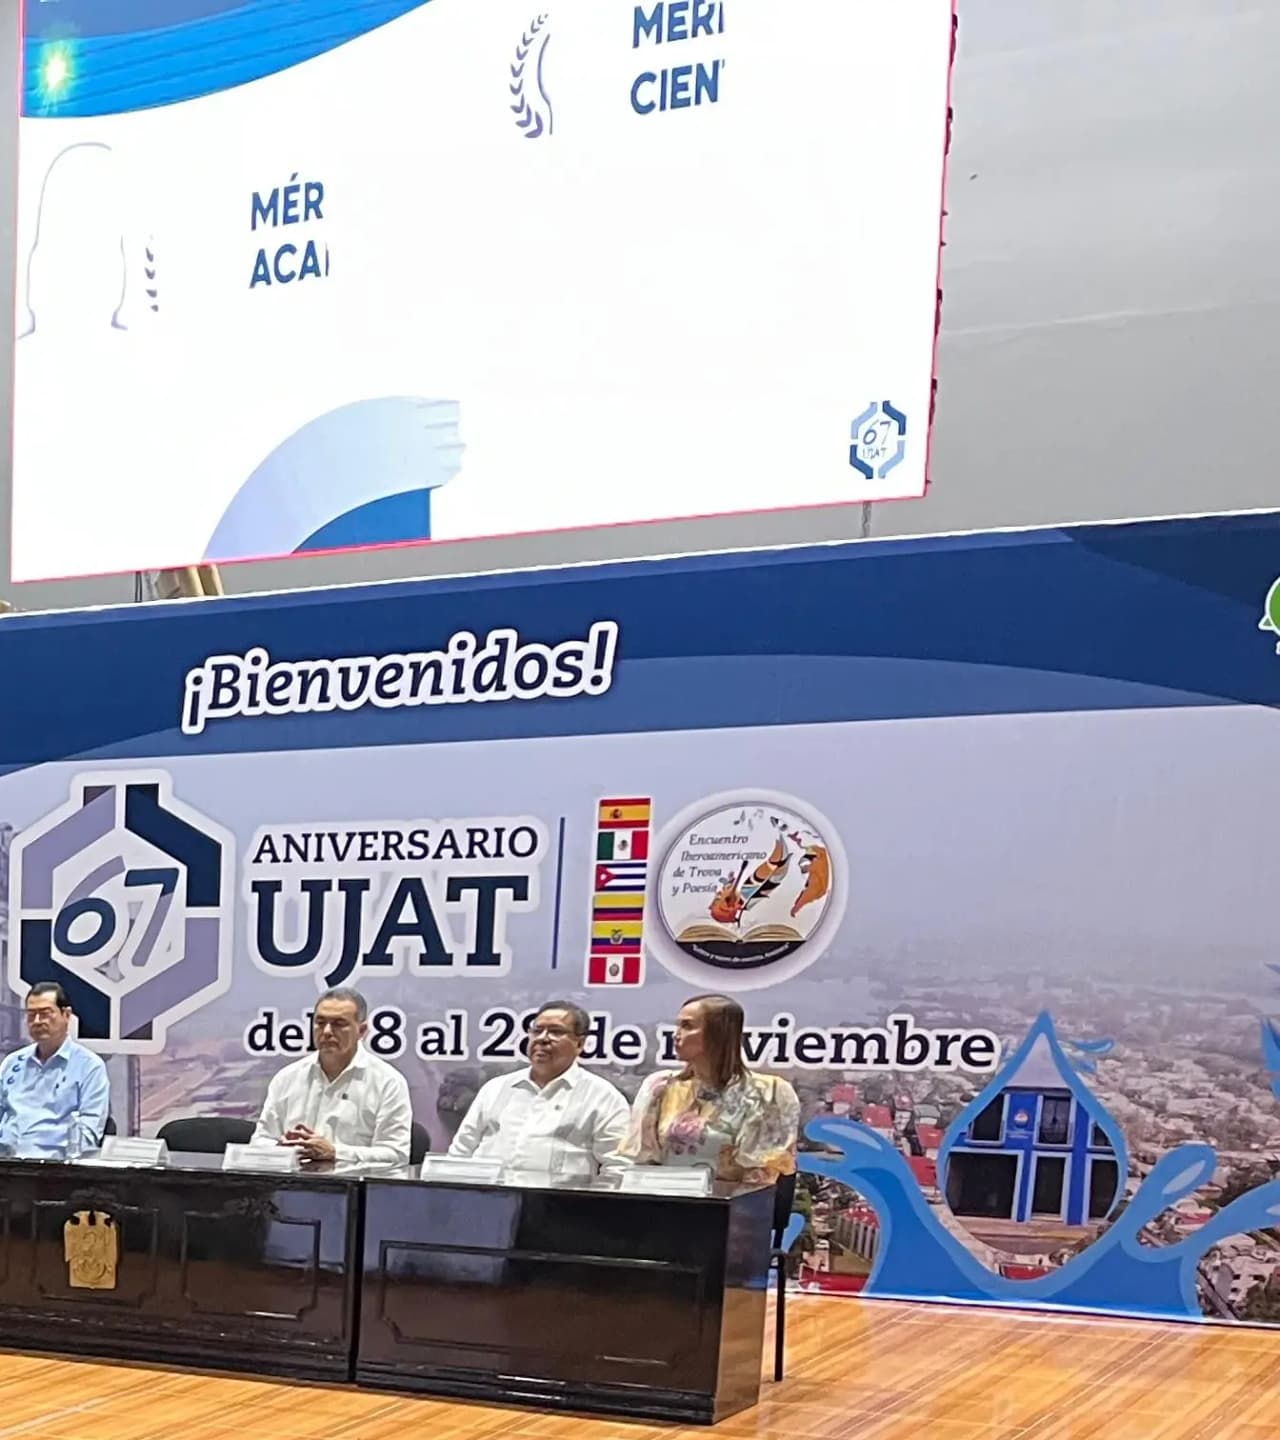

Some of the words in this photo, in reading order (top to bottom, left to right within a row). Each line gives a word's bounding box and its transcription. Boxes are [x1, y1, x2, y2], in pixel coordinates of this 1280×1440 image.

[630, 59, 725, 115] CIEN
[251, 172, 324, 231] MÉR
[249, 240, 329, 289] ACA
[187, 629, 610, 728] ¡Bienvenidos!
[252, 826, 538, 864] ANIVERSARIO
[53, 855, 180, 967] 67
[251, 875, 530, 986] UJAT
[420, 1014, 463, 1056] al
